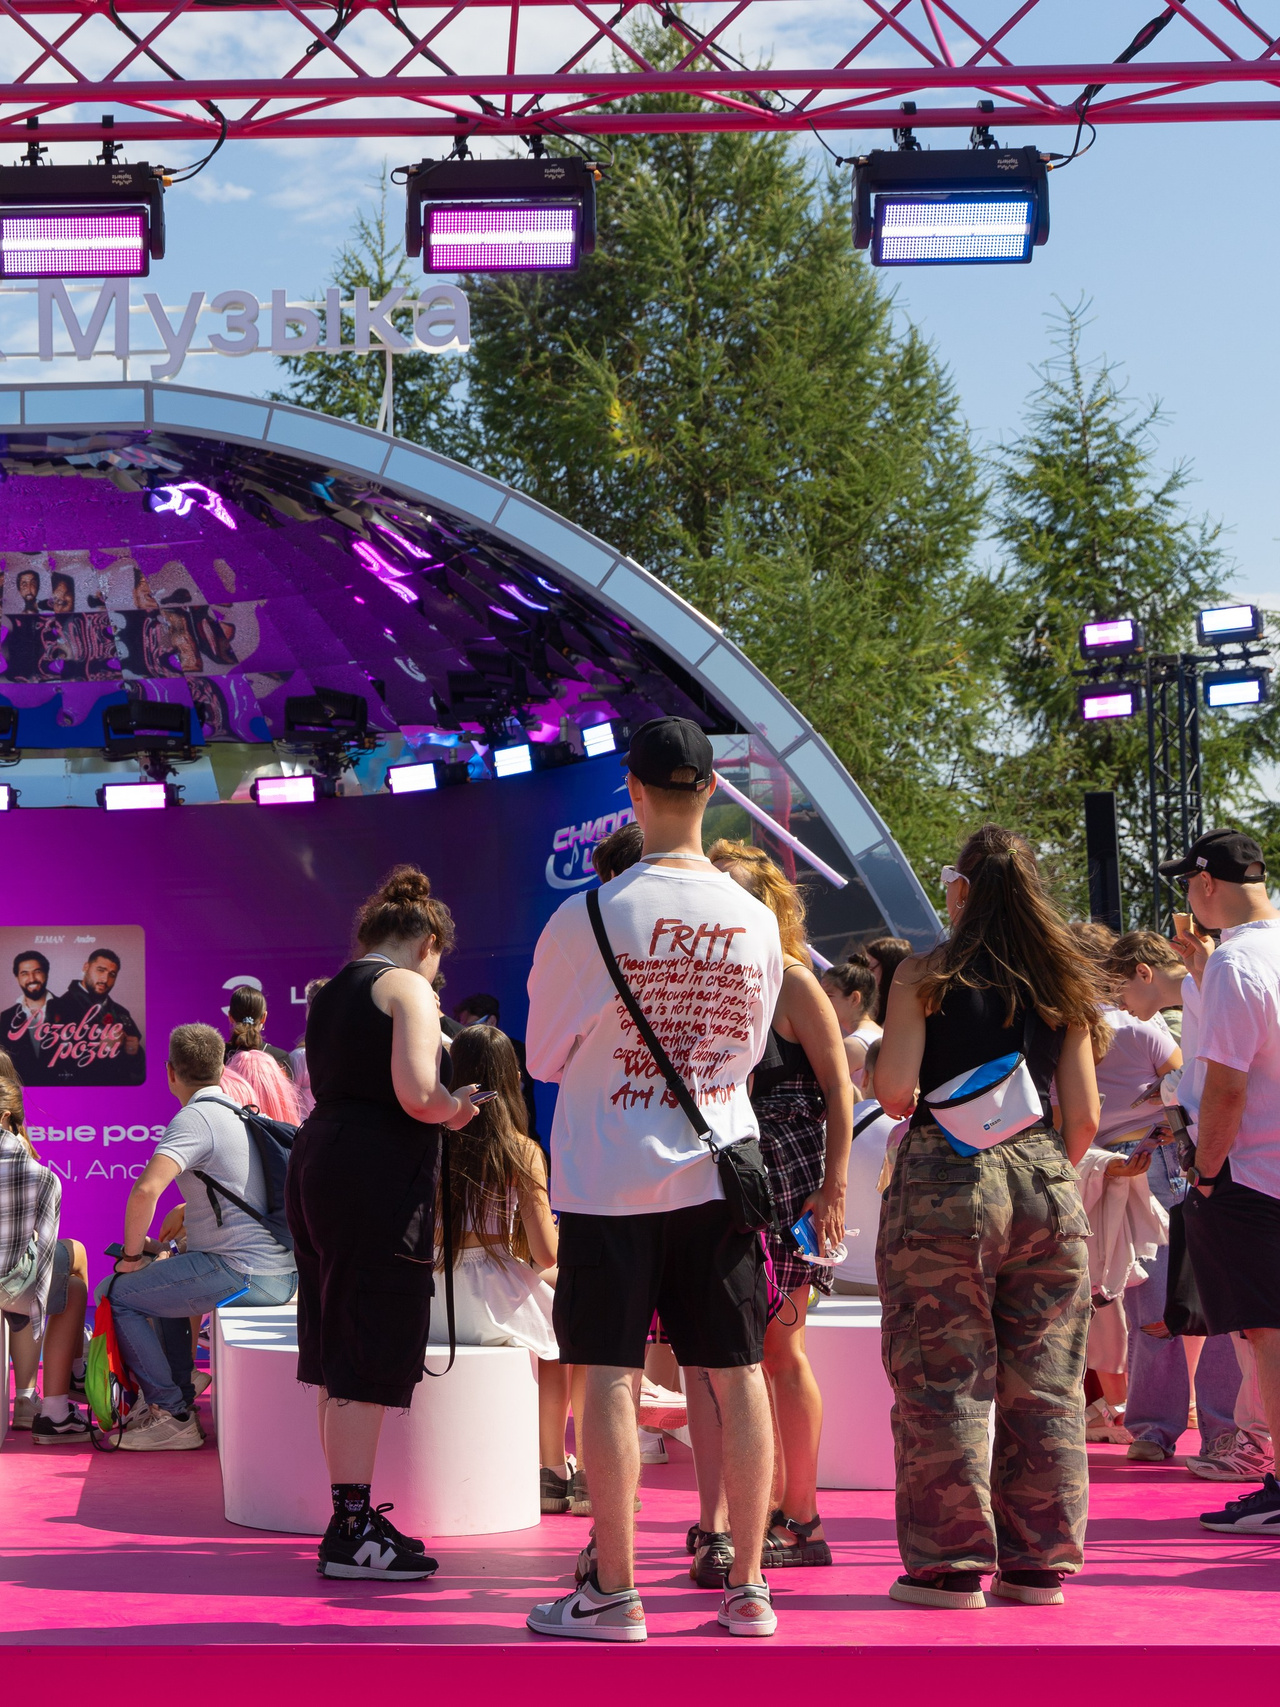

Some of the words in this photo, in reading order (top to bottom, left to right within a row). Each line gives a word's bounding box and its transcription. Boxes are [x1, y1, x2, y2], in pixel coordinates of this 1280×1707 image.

[37, 277, 471, 379] Музыка
[34, 935, 65, 944] ELMAN
[74, 935, 96, 944] Andro
[7, 1004, 124, 1050] Розовые
[47, 1036, 121, 1068] розы
[610, 1081, 655, 1110] Art
[103, 1125, 168, 1147] роз
